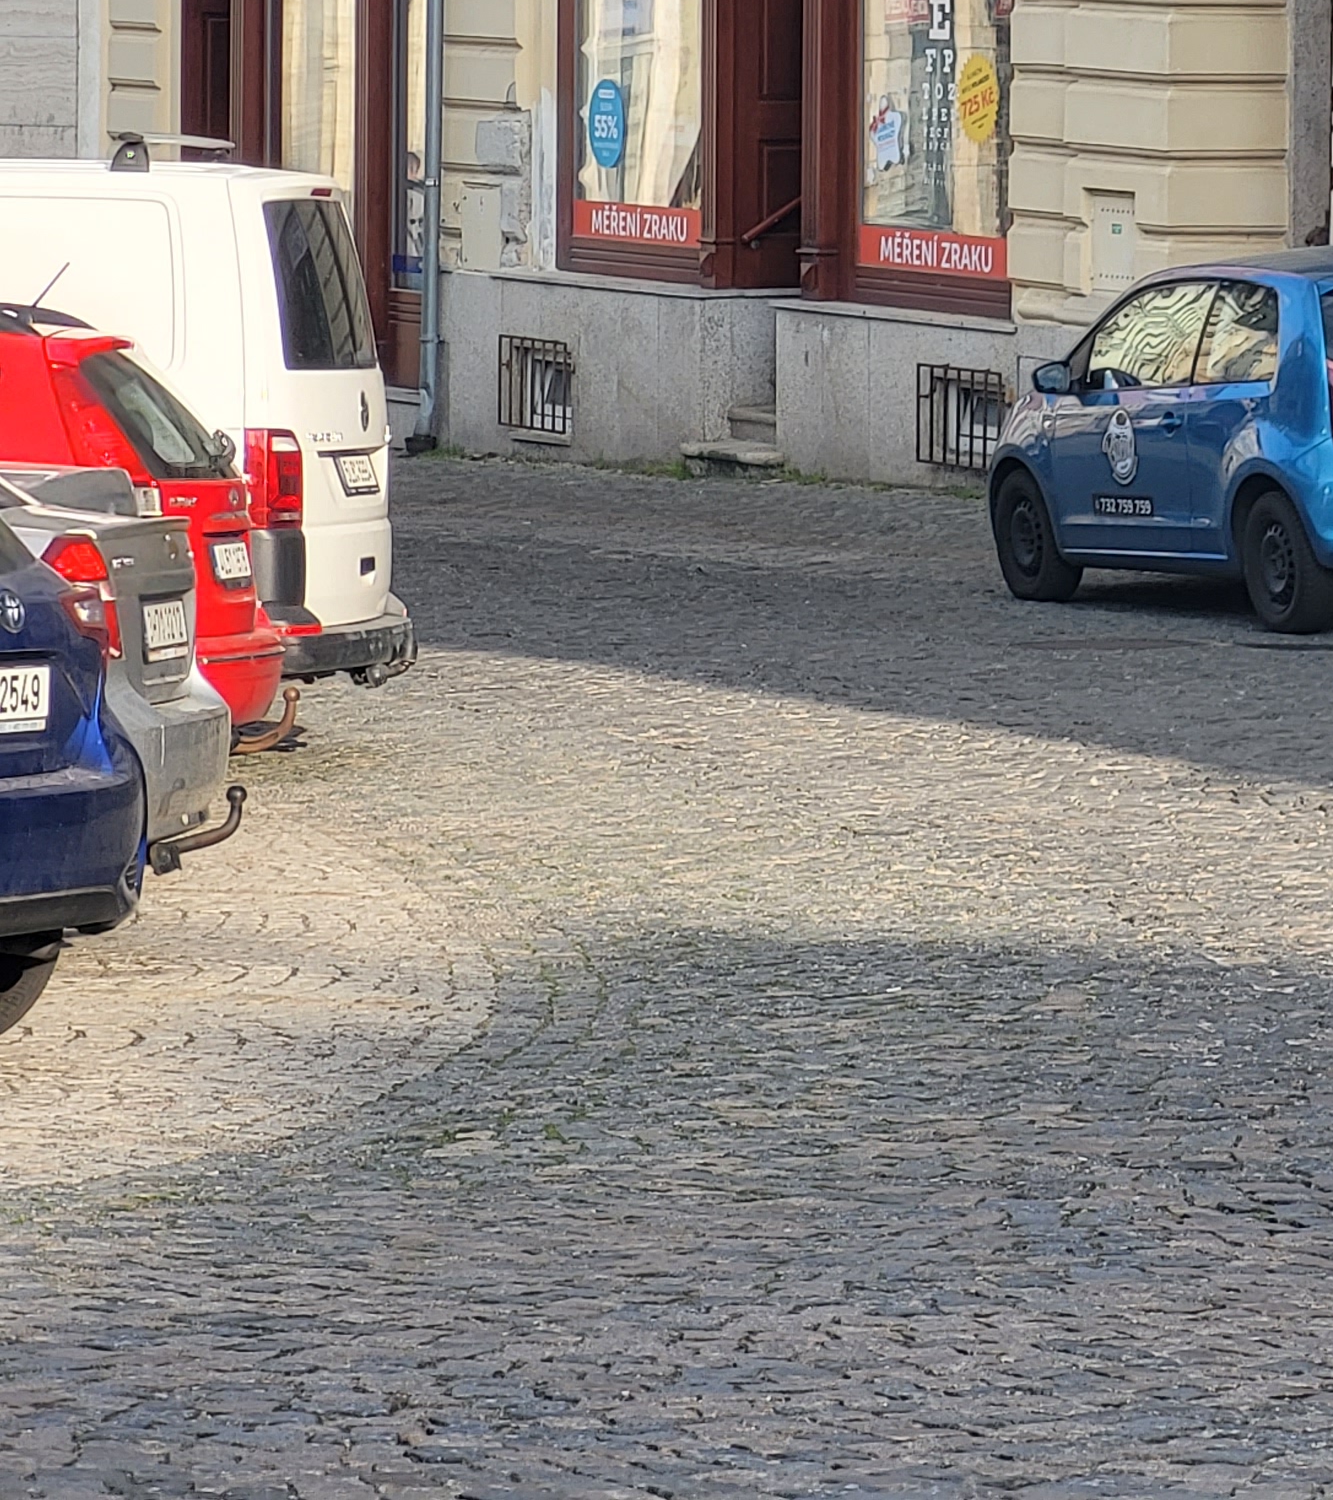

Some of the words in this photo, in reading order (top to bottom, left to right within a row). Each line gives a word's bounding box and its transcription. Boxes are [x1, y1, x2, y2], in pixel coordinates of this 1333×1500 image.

[925, 49, 936, 73] F
[943, 49, 954, 73] P
[961, 91, 980, 120] 725
[594, 114, 619, 139] 55%
[591, 205, 640, 238] MĚŘENÍ
[643, 213, 687, 242] ZRAKU
[880, 231, 938, 267] MĚŘENÍ
[941, 242, 992, 273] ZRAKU
[1100, 497, 1116, 512] 732
[1117, 499, 1133, 514] 759
[1134, 500, 1151, 515] 759
[0, 674, 41, 714] 2549
